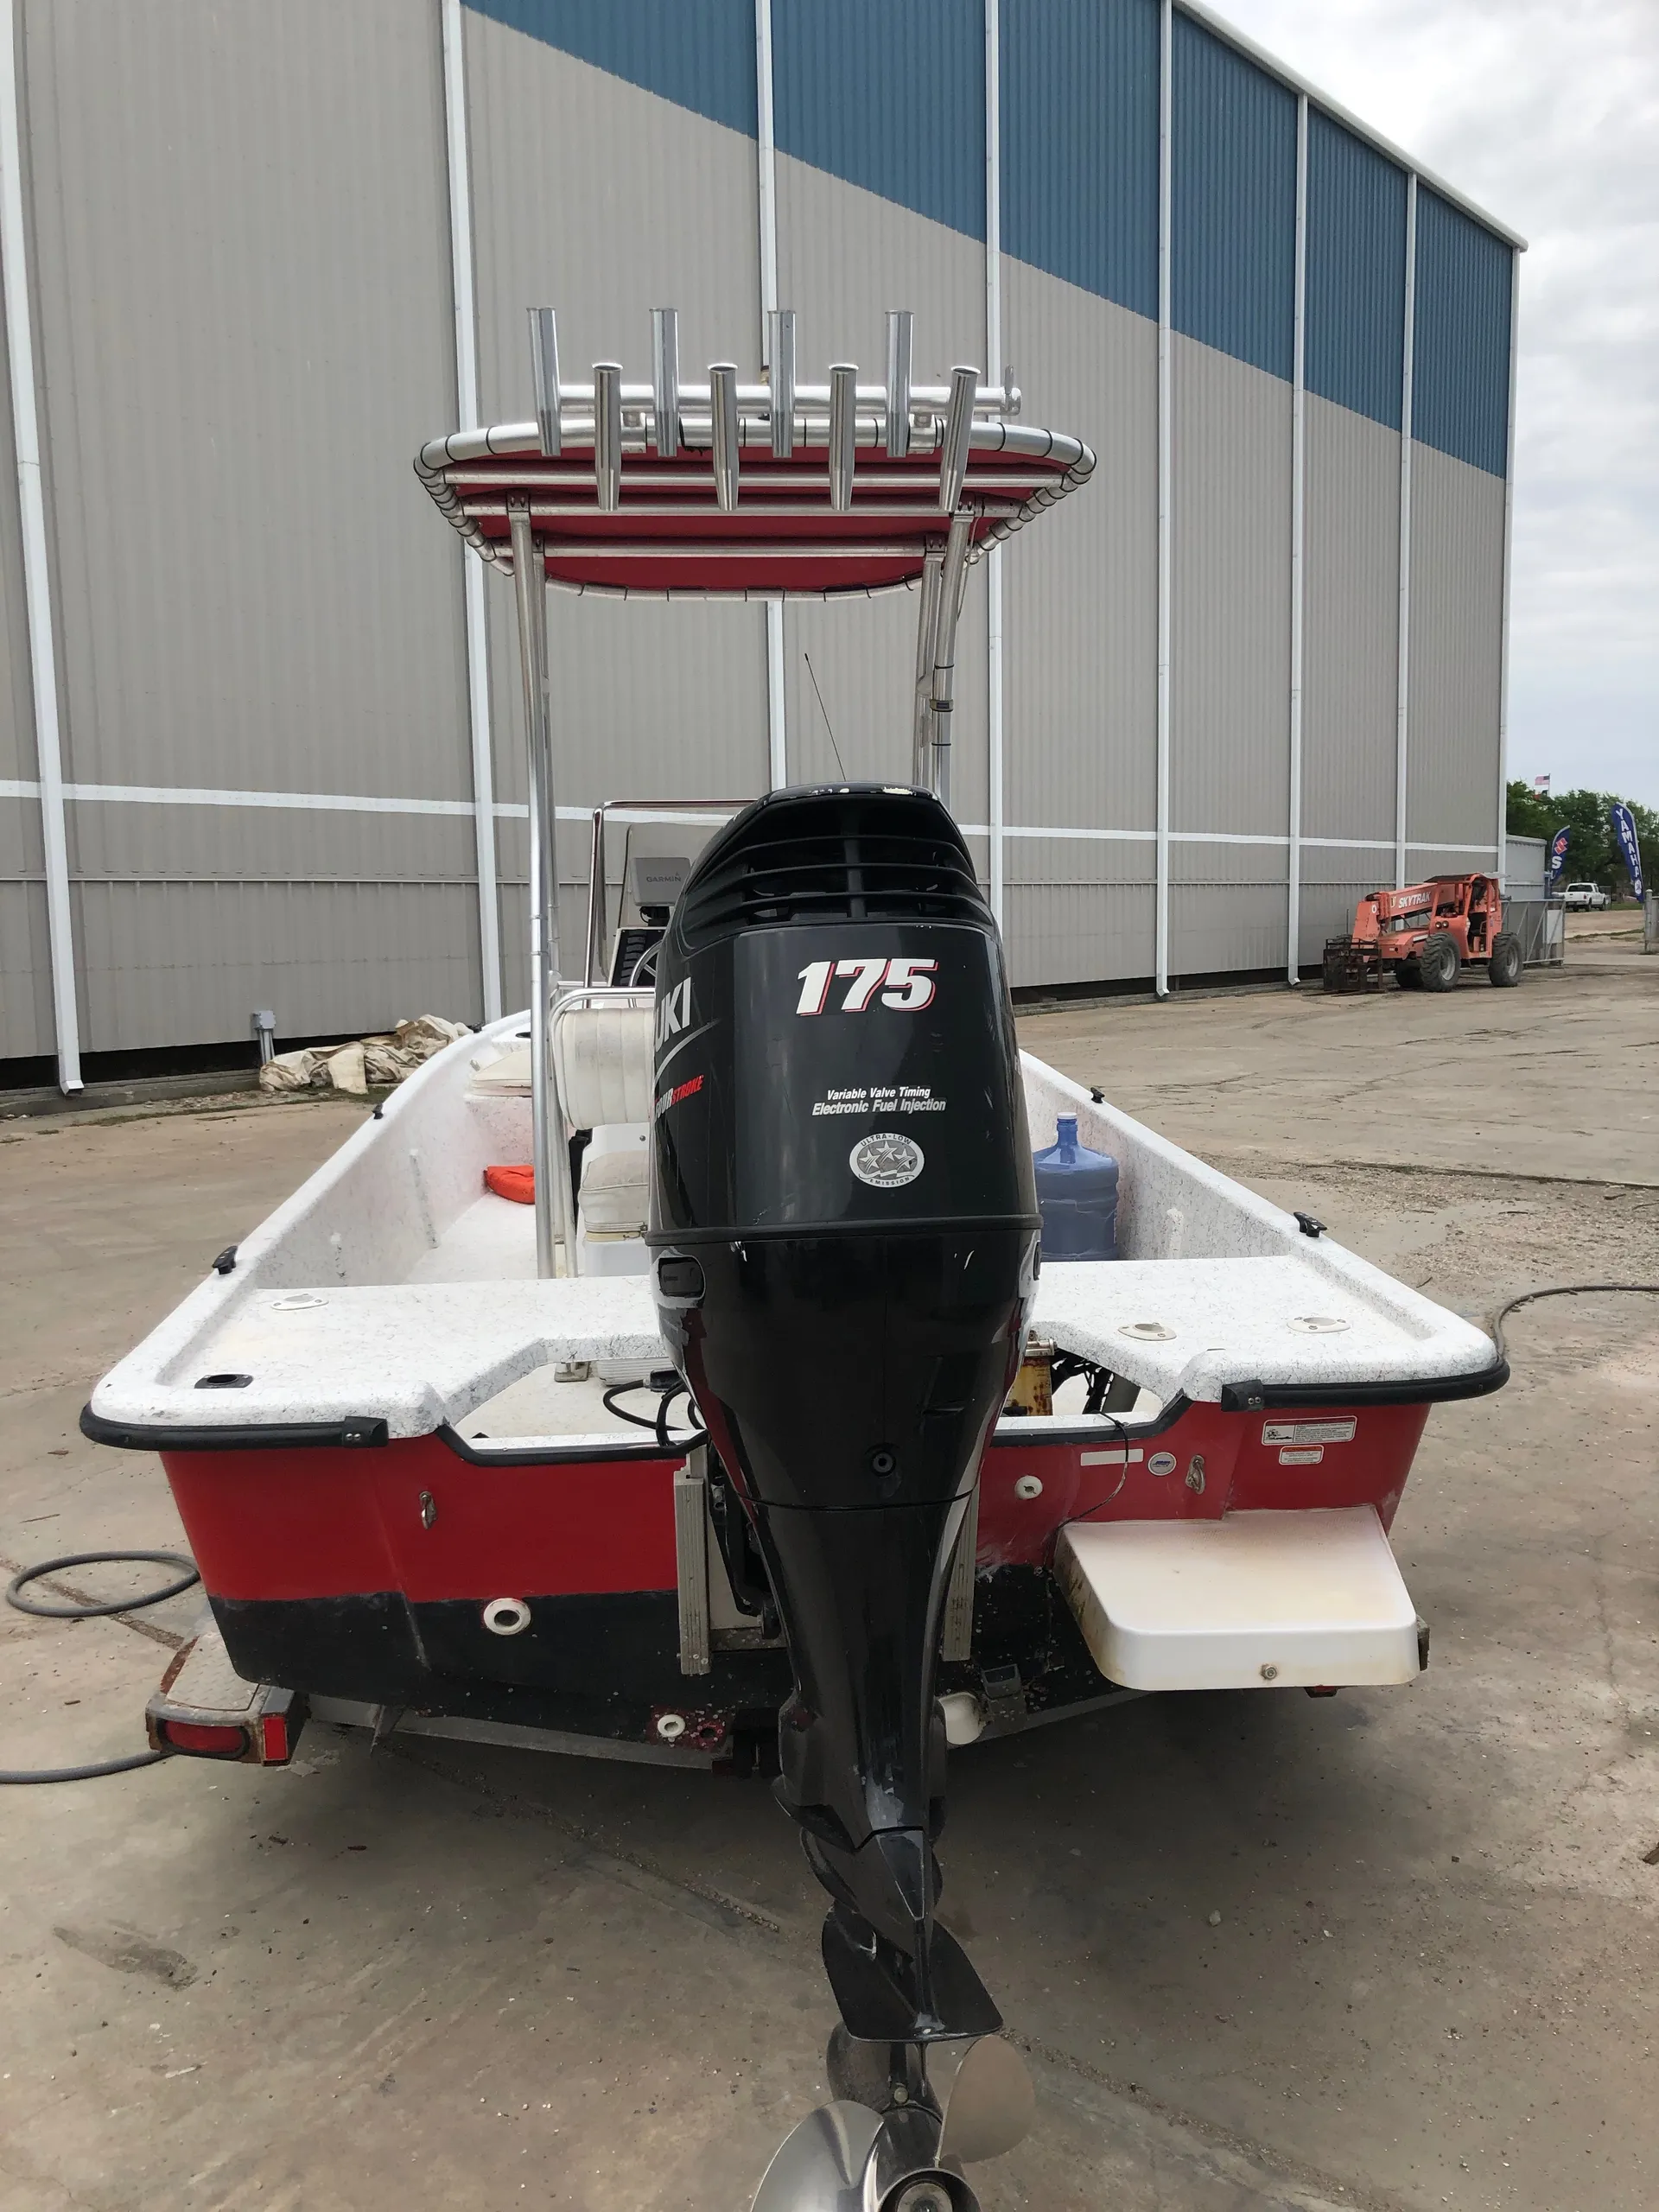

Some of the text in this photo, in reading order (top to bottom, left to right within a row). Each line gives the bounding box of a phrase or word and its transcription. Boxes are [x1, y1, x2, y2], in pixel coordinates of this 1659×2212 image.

[1615, 808, 1640, 878] YAMAHA
[1398, 892, 1432, 909] SKYTRAK
[796, 957, 938, 1016] 175
[827, 1086, 931, 1101] Variable Valve Timing
[811, 1097, 946, 1116] Electronic Fuel Injection
[869, 1177, 910, 1185] EMISSION
